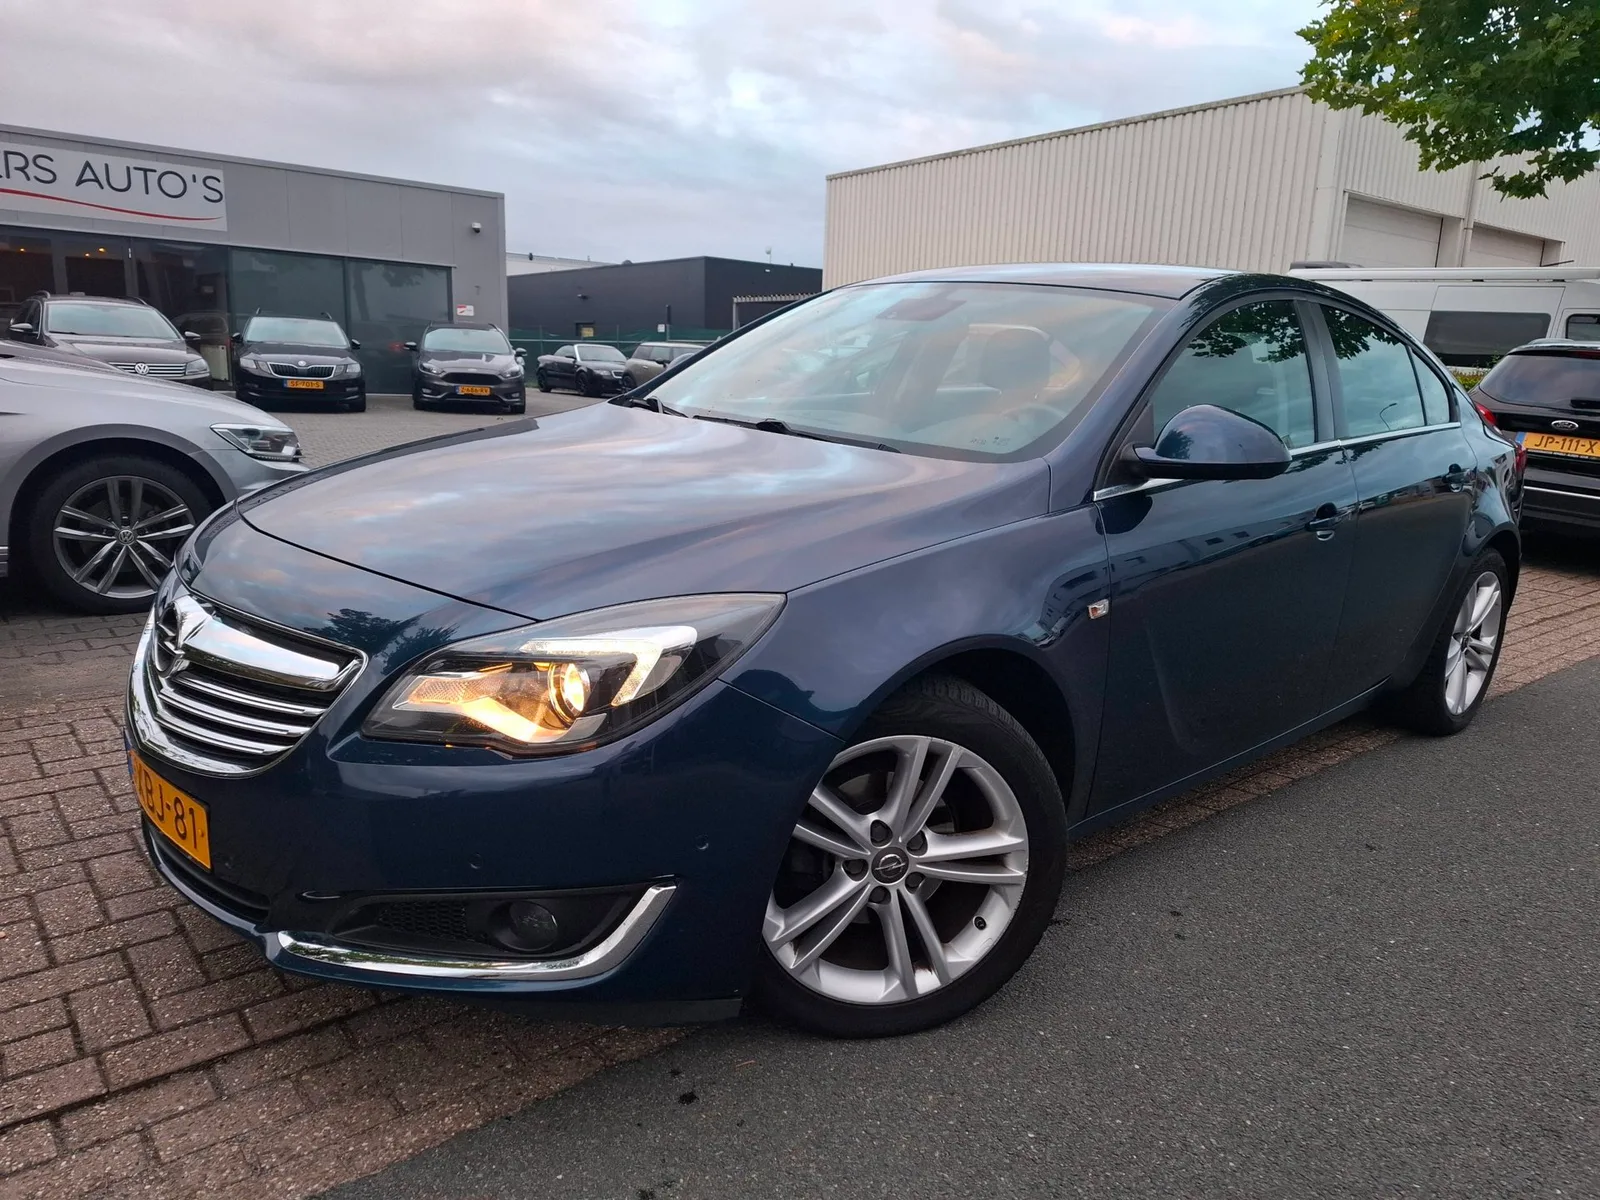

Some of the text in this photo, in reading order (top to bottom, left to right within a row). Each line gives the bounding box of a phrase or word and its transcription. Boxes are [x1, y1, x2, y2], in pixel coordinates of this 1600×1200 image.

[0, 150, 224, 203] RS AUTO'S
[1534, 435, 1598, 453] JP-111-X
